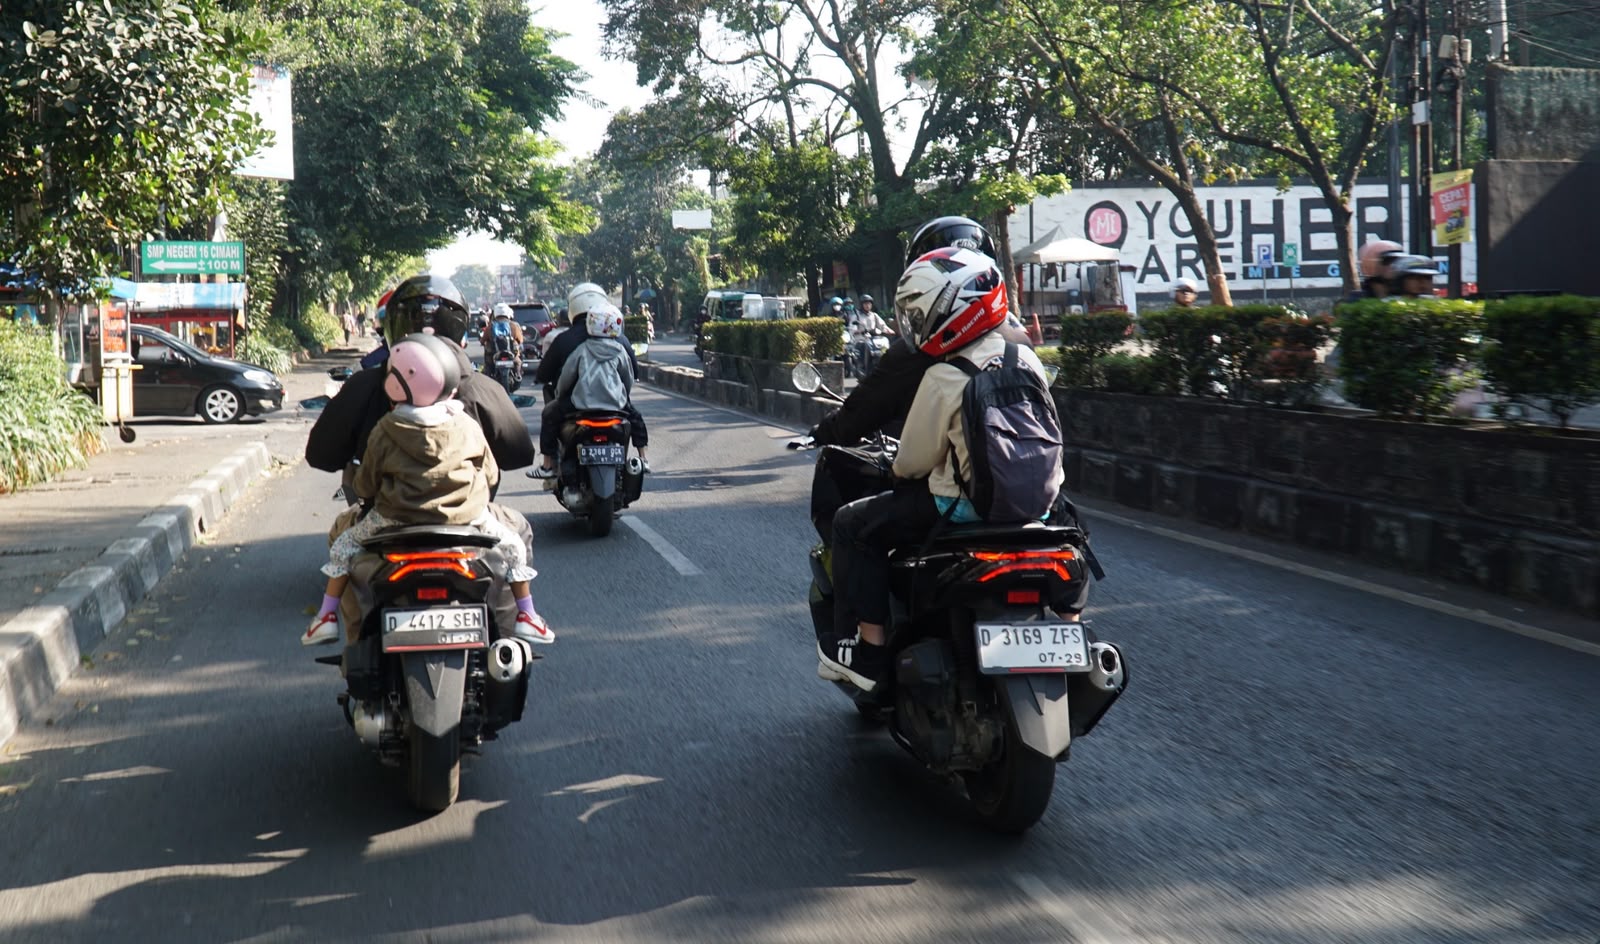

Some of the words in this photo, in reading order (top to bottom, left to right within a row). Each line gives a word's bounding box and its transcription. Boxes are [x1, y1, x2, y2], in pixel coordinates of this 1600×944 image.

[1135, 199, 1234, 239] YOU
[147, 244, 164, 258] SMP
[166, 244, 197, 259] NEGERI
[199, 245, 209, 259] 16
[210, 245, 240, 259] CIMAHI
[1260, 246, 1271, 261] P
[230, 260, 240, 270] M
[1137, 242, 1237, 284] ARE
[961, 307, 986, 335] Racing
[388, 616, 398, 632] D
[409, 614, 446, 630] 4412
[454, 612, 481, 628] SEN
[980, 628, 991, 647] D
[1001, 627, 1043, 646] 3169
[1049, 627, 1082, 645] ZFS
